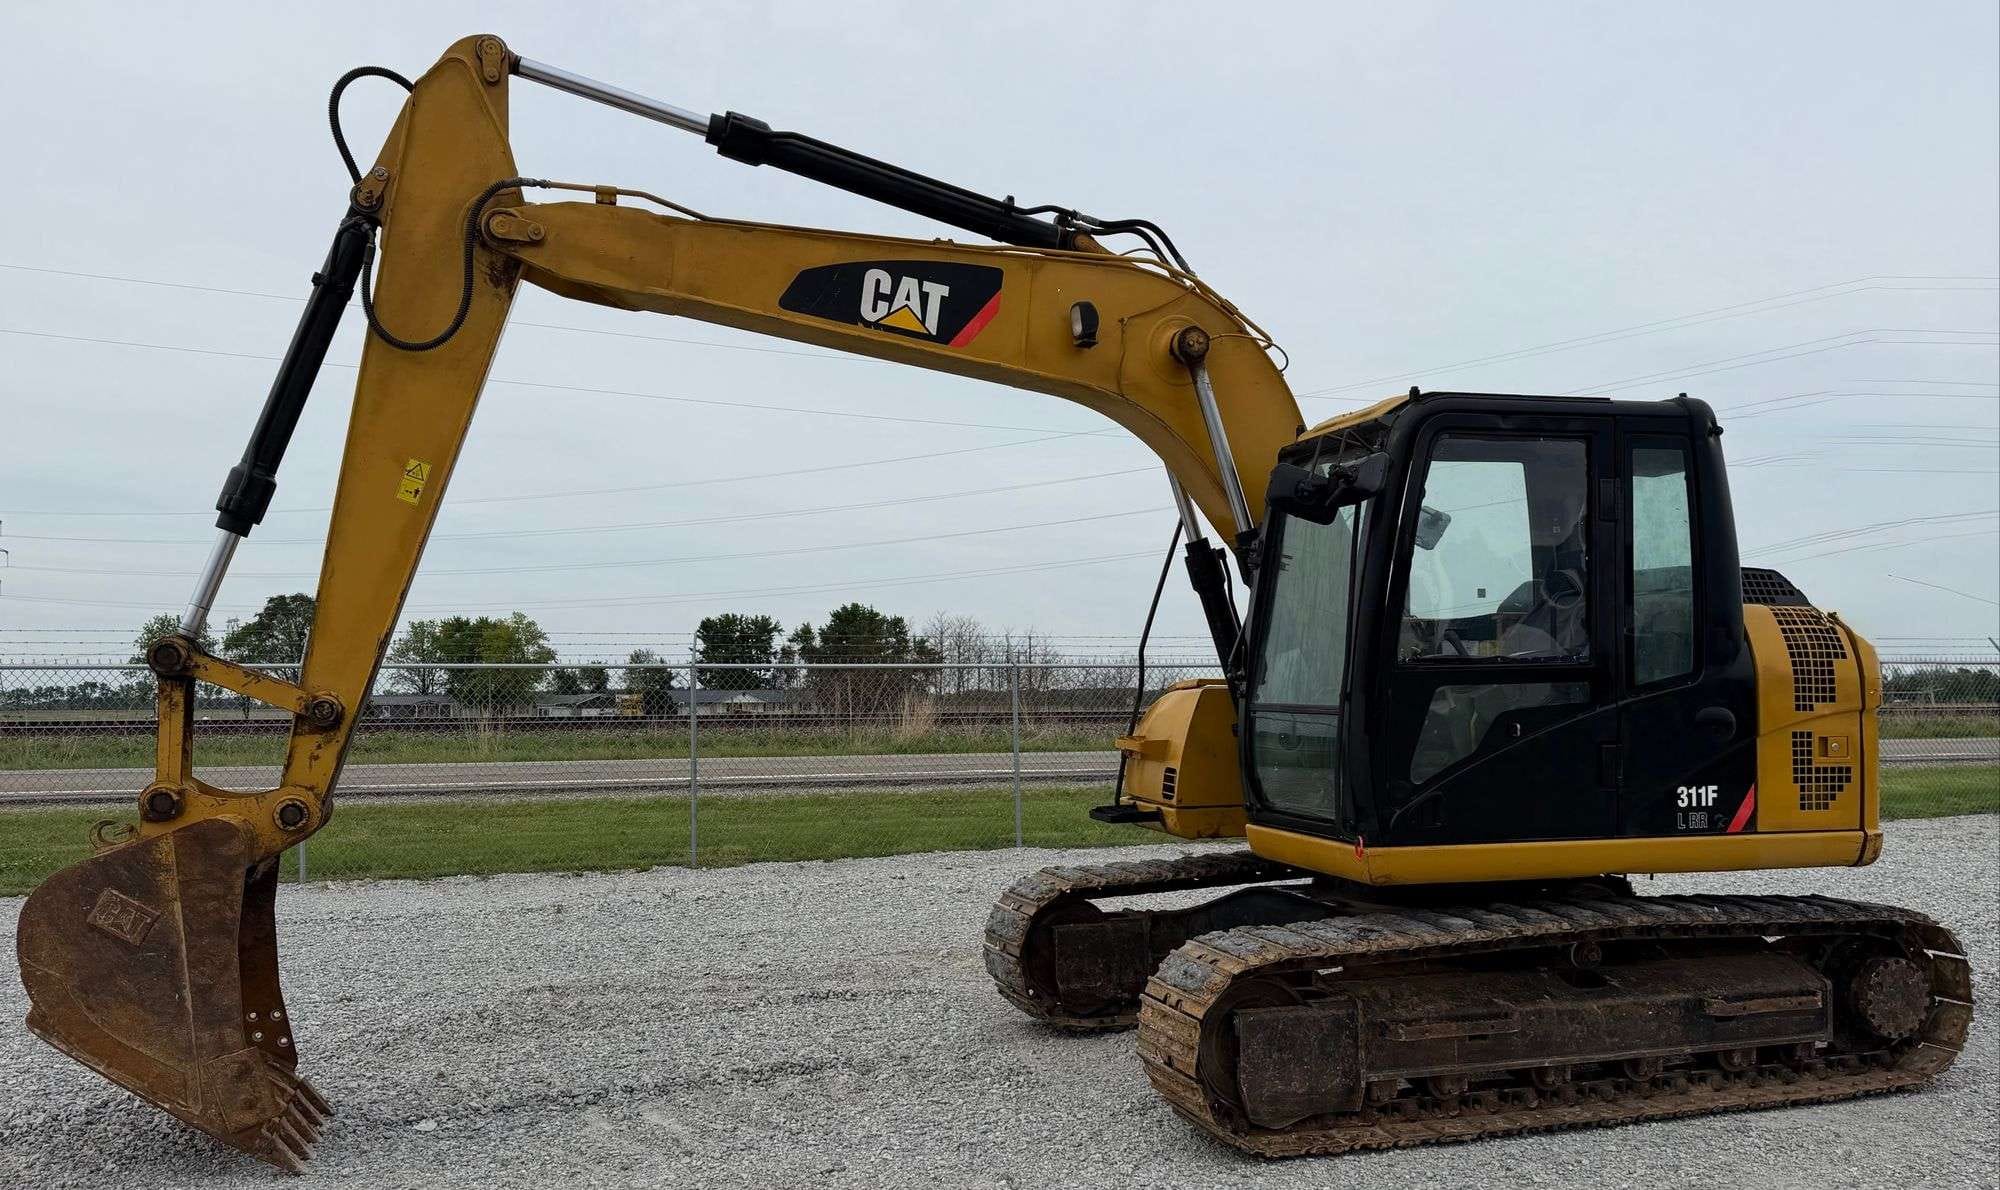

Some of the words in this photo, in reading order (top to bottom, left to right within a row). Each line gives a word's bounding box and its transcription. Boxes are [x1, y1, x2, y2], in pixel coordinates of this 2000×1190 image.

[860, 268, 950, 336] CAT
[1677, 785, 1718, 808] 311F
[1677, 812, 1686, 829] L
[1688, 812, 1708, 829] RR
[94, 893, 152, 939] CAT
